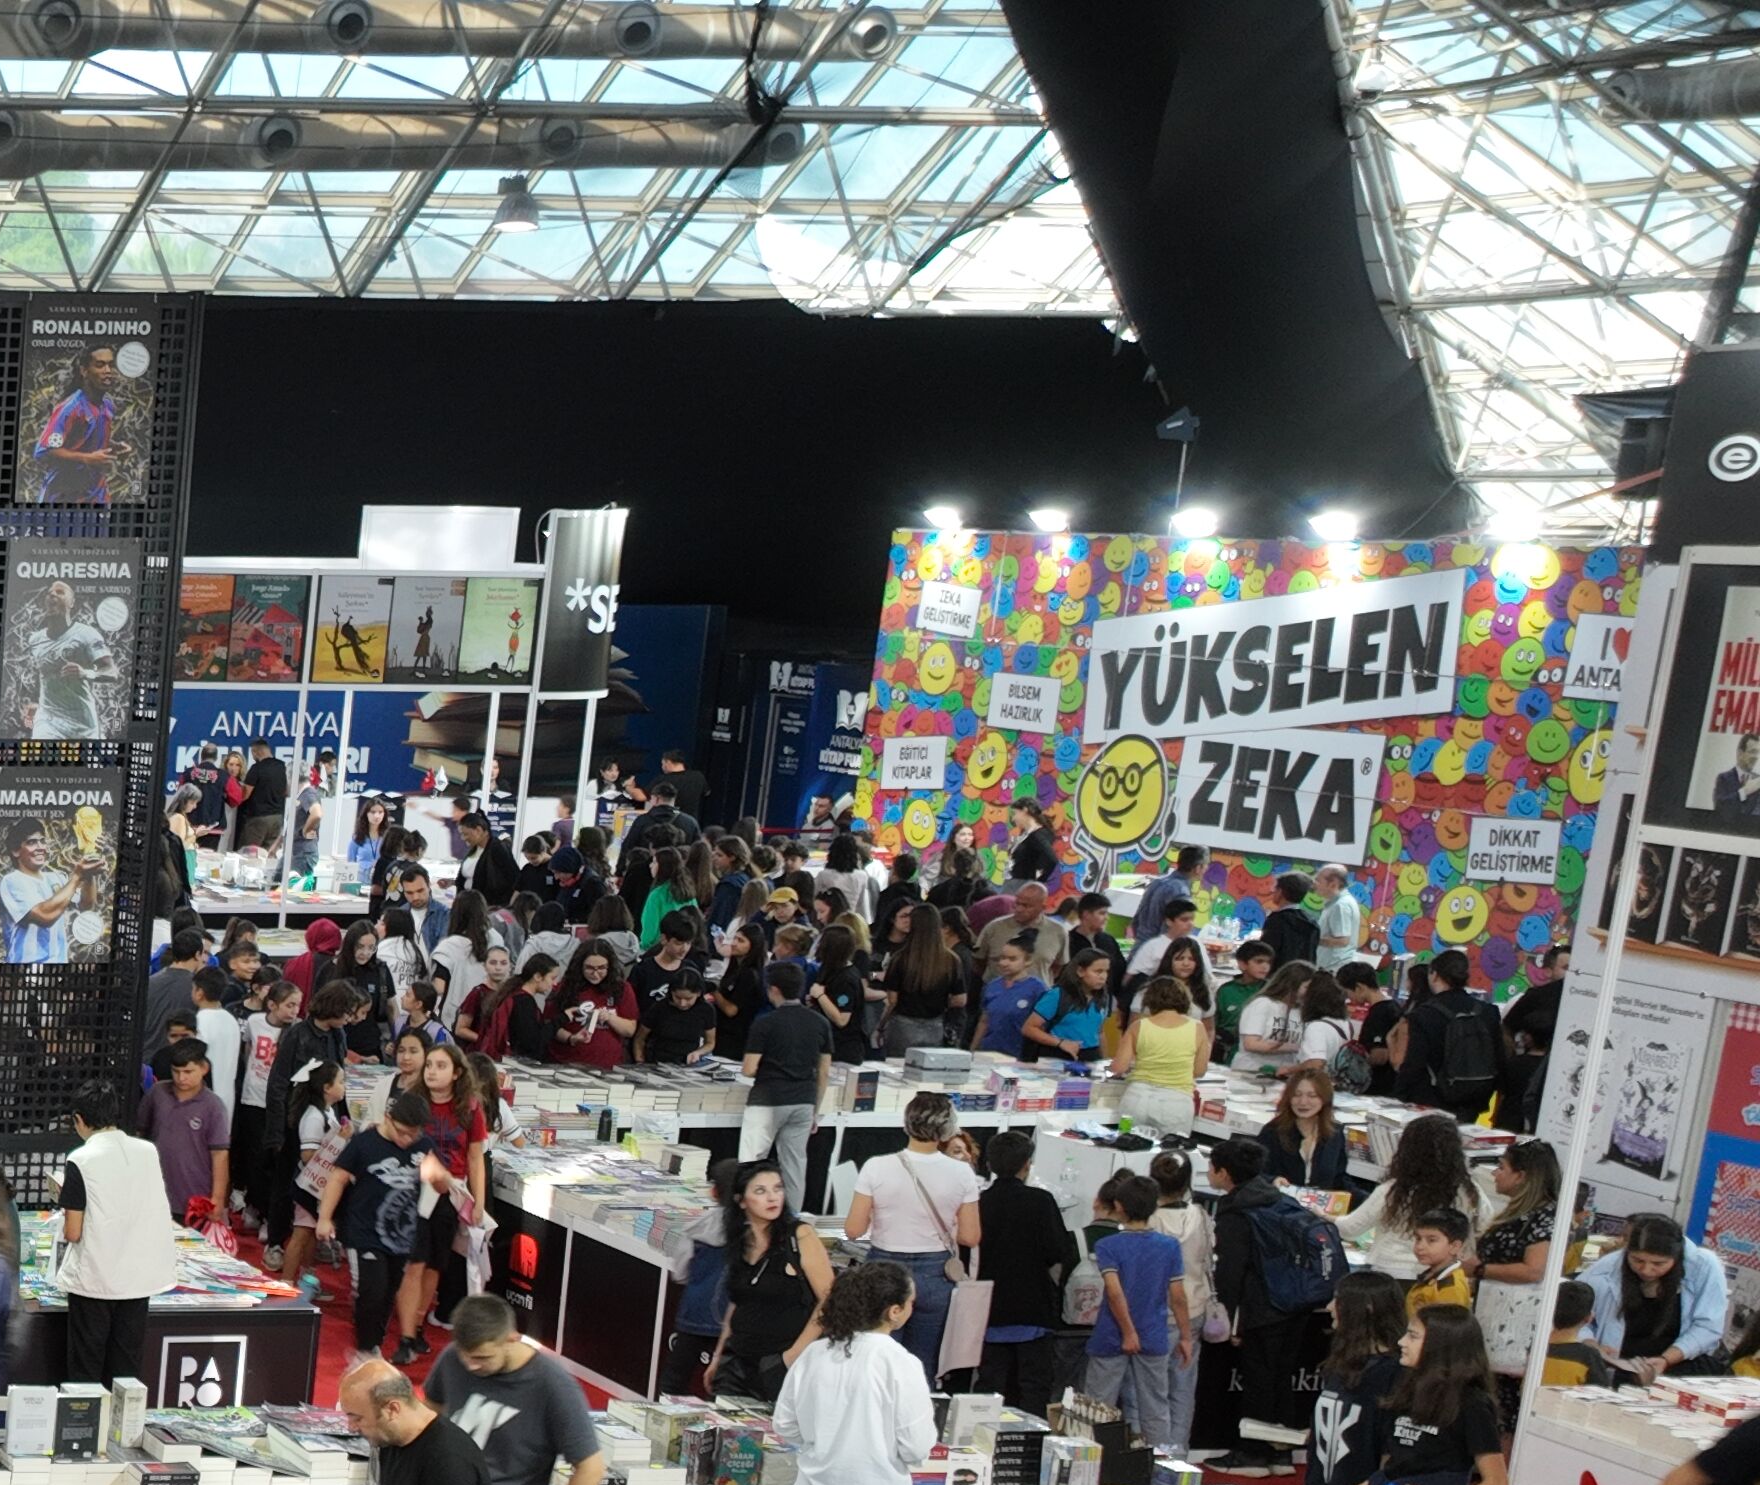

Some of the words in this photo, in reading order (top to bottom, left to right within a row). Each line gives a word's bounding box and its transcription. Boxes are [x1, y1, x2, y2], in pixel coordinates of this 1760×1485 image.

[32, 318, 152, 336] RONALDINHO
[16, 562, 132, 581] QUARESMA
[939, 589, 962, 607] ZEKA
[922, 606, 973, 630] GELİŞTİRME
[1100, 600, 1451, 731] YÜKSELEN
[1007, 682, 1042, 702] BİLSEM
[1000, 705, 1043, 723] HAZIRLIK
[898, 744, 928, 760] EĞİTİCİ
[891, 765, 933, 780] KİTAPLAR
[1188, 738, 1357, 847] ZEKA
[1489, 824, 1540, 849] DİKKAT
[1470, 846, 1557, 875] GELİŞTİRME
[180, 1356, 221, 1382] PA
